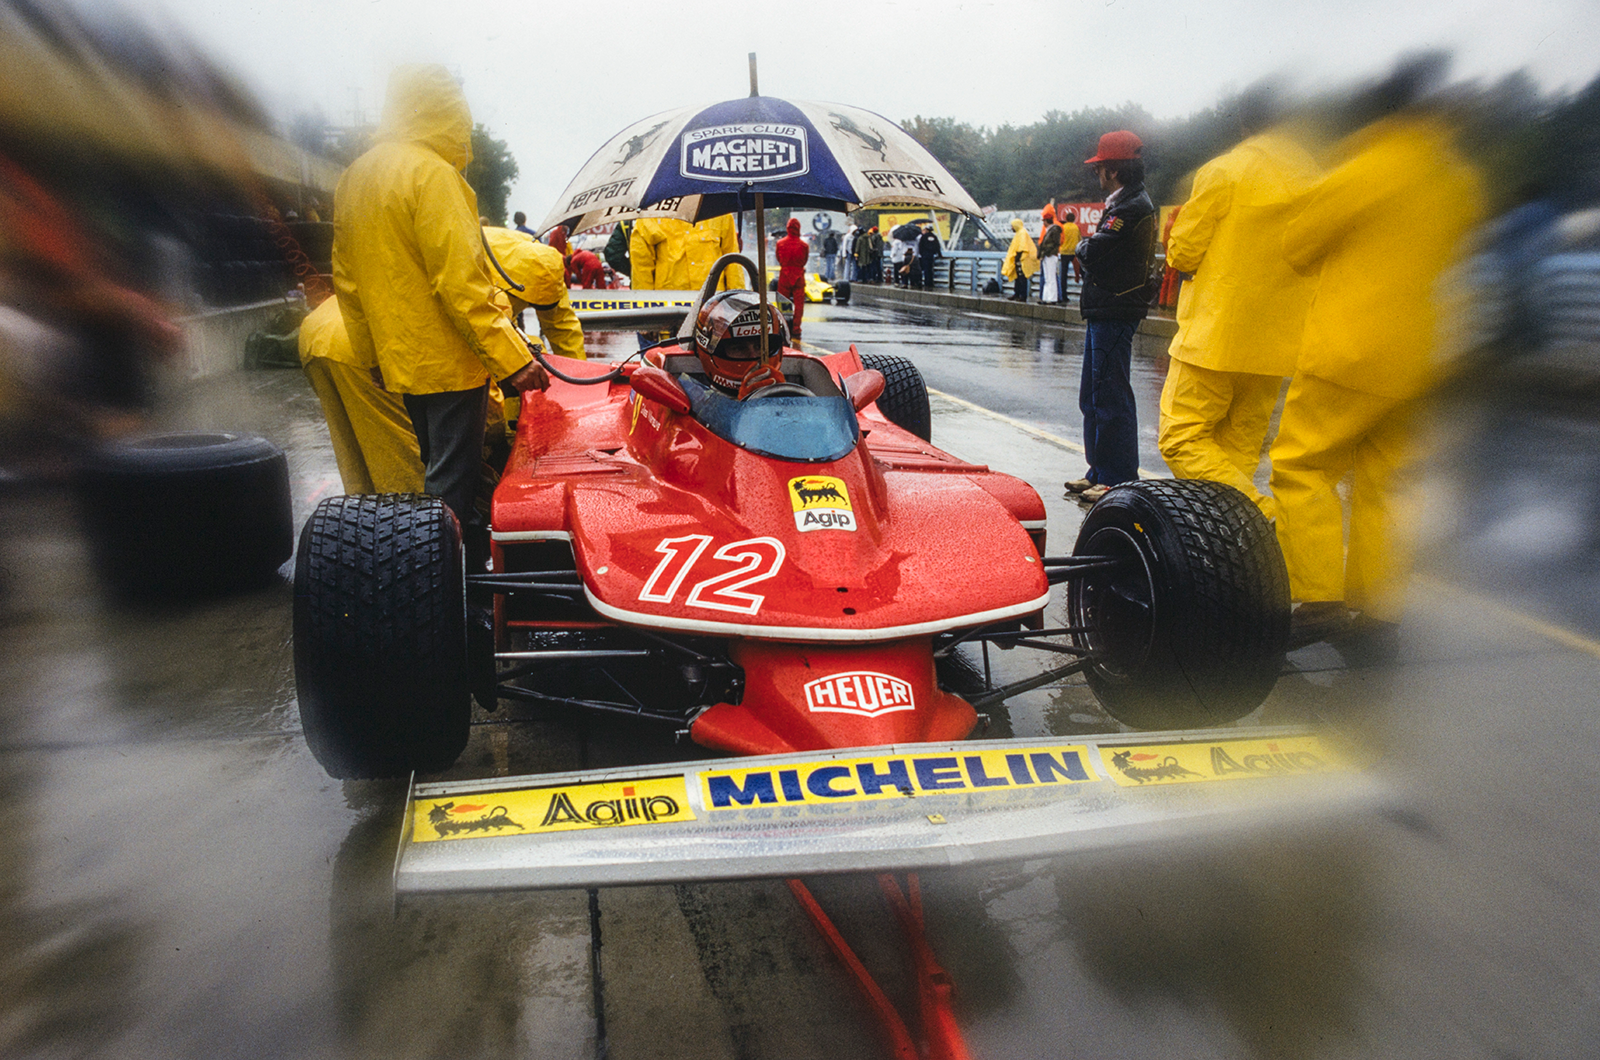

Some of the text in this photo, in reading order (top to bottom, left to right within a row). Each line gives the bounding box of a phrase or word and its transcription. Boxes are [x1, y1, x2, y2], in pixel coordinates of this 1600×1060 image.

[691, 125, 797, 141] SPARK CLUB
[692, 138, 797, 160] MAGNETI
[692, 153, 797, 172] MARELLI
[564, 177, 637, 214] Ferrari
[863, 170, 946, 196] Ferrari
[803, 509, 851, 527] Agip
[638, 534, 787, 615] 12
[814, 674, 911, 714] HEUER
[539, 742, 1321, 827] Agip MICHELIN Agip
